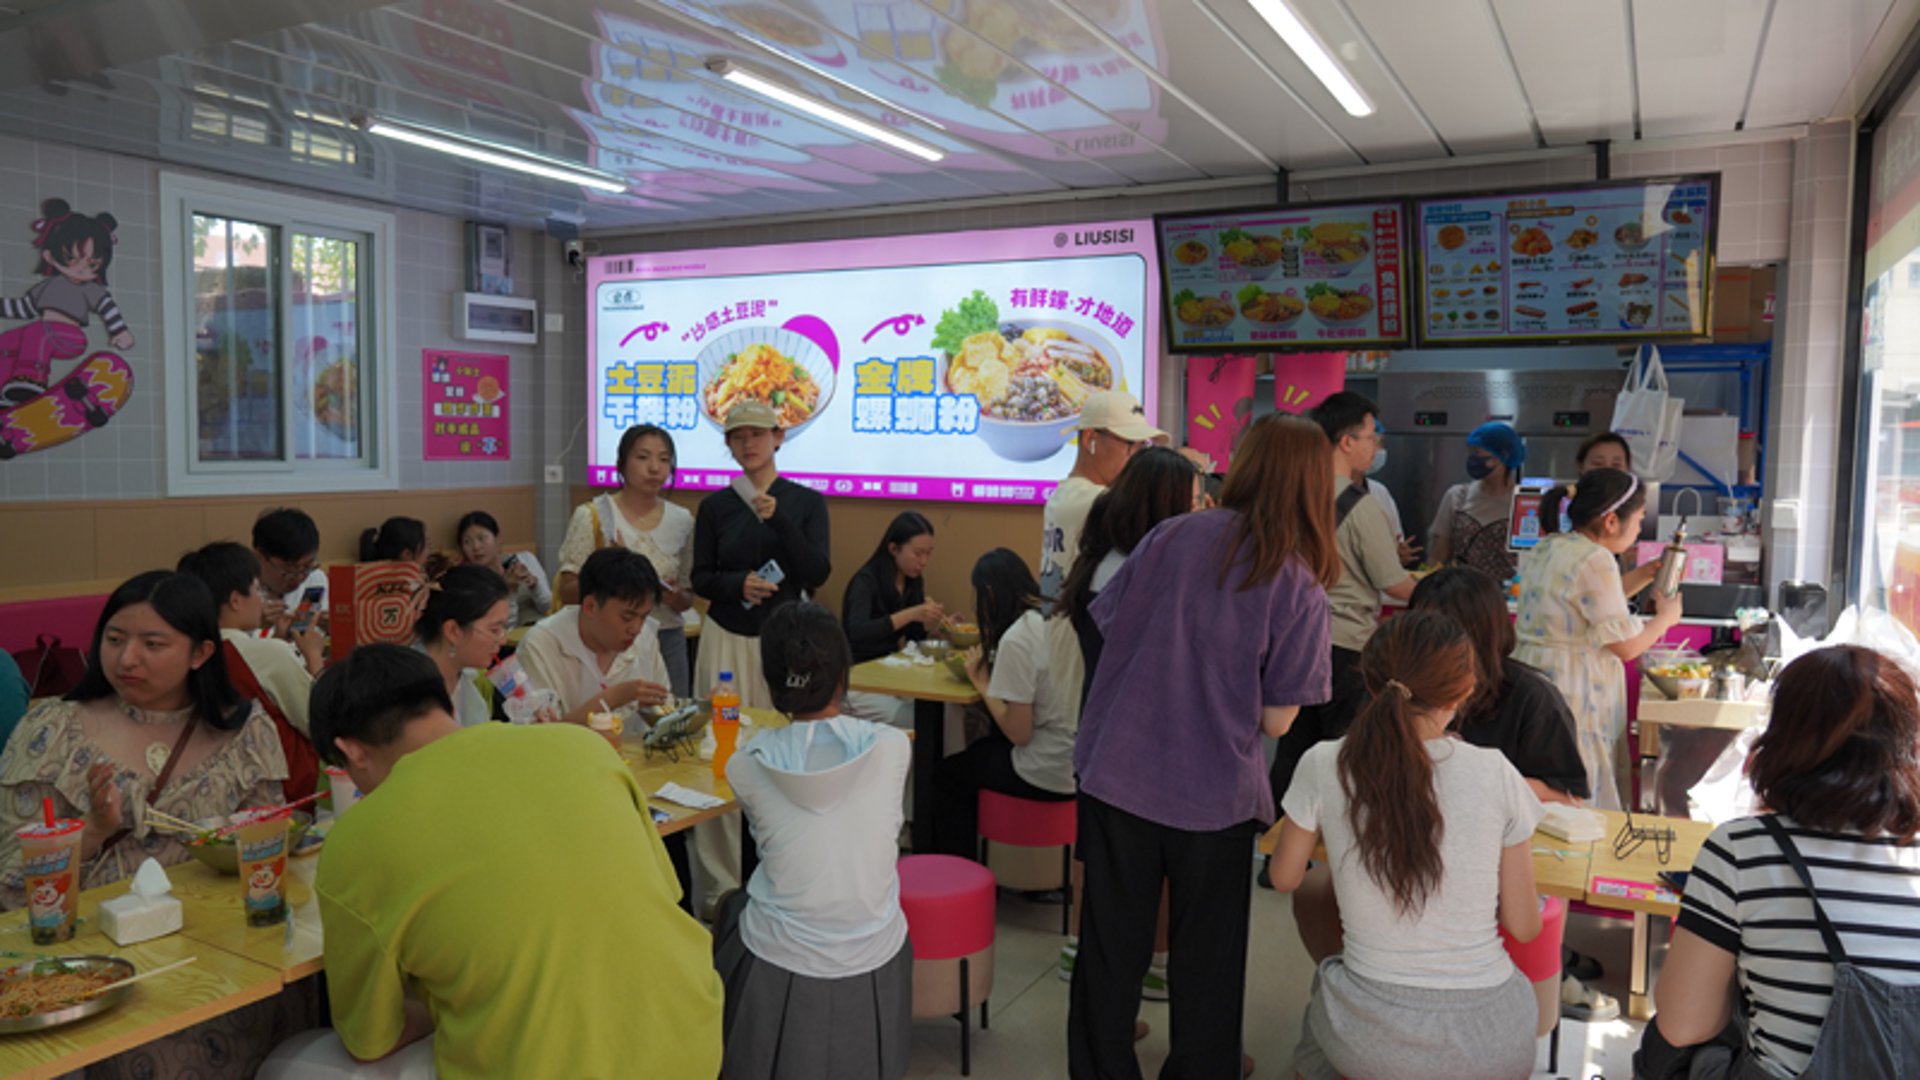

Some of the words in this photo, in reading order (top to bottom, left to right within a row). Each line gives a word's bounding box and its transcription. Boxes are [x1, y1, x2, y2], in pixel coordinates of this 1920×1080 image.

[1074, 228, 1135, 246] LIUSISI
[605, 361, 699, 395] 土豆泥
[854, 356, 937, 395] 金牌
